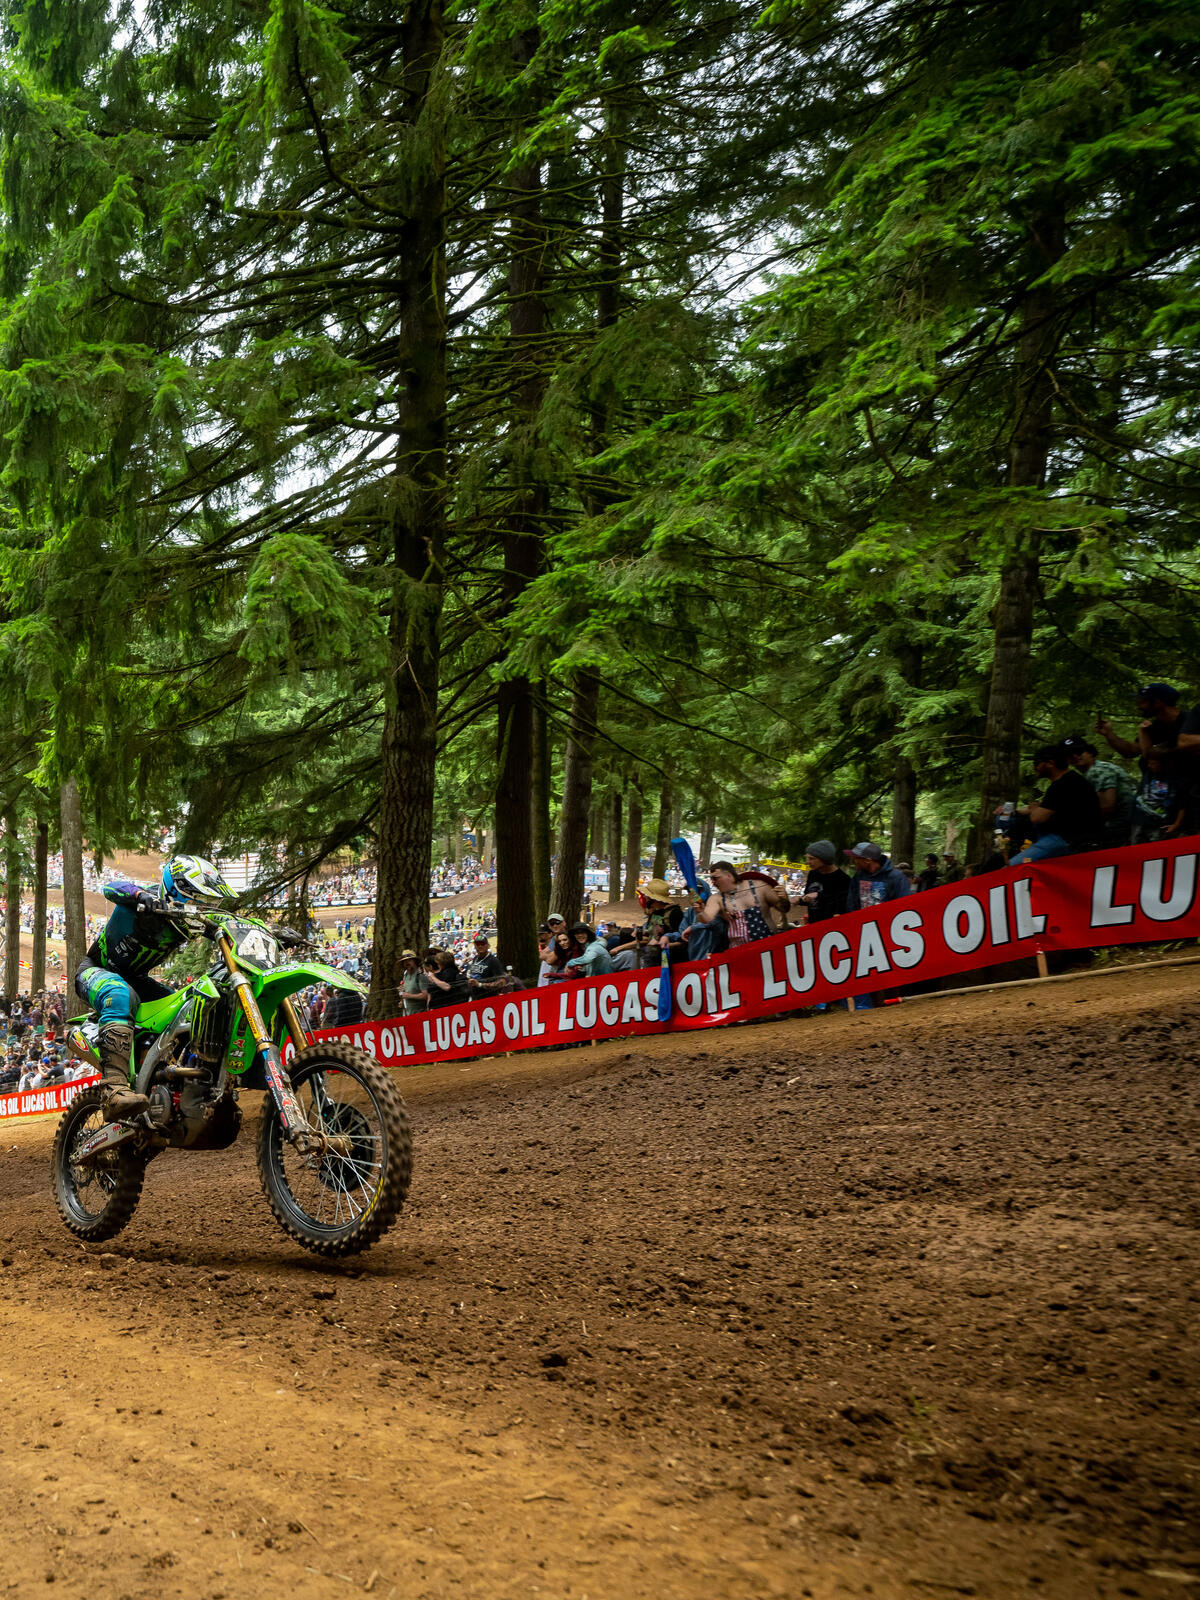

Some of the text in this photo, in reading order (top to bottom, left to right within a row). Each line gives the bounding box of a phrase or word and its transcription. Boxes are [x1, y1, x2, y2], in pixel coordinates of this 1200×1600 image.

[238, 929, 277, 964] 47
[381, 1025, 415, 1059] OIL
[422, 1006, 497, 1053] LUCAS
[502, 998, 546, 1041] OIL
[558, 976, 661, 1032] LUCAS
[676, 963, 741, 1018] OIL
[760, 909, 925, 1001] LUCAS
[942, 877, 1048, 955] OIL
[7, 1096, 19, 1115] OIL
[21, 1091, 45, 1113] LUCAS
[45, 1090, 59, 1110] OIL
